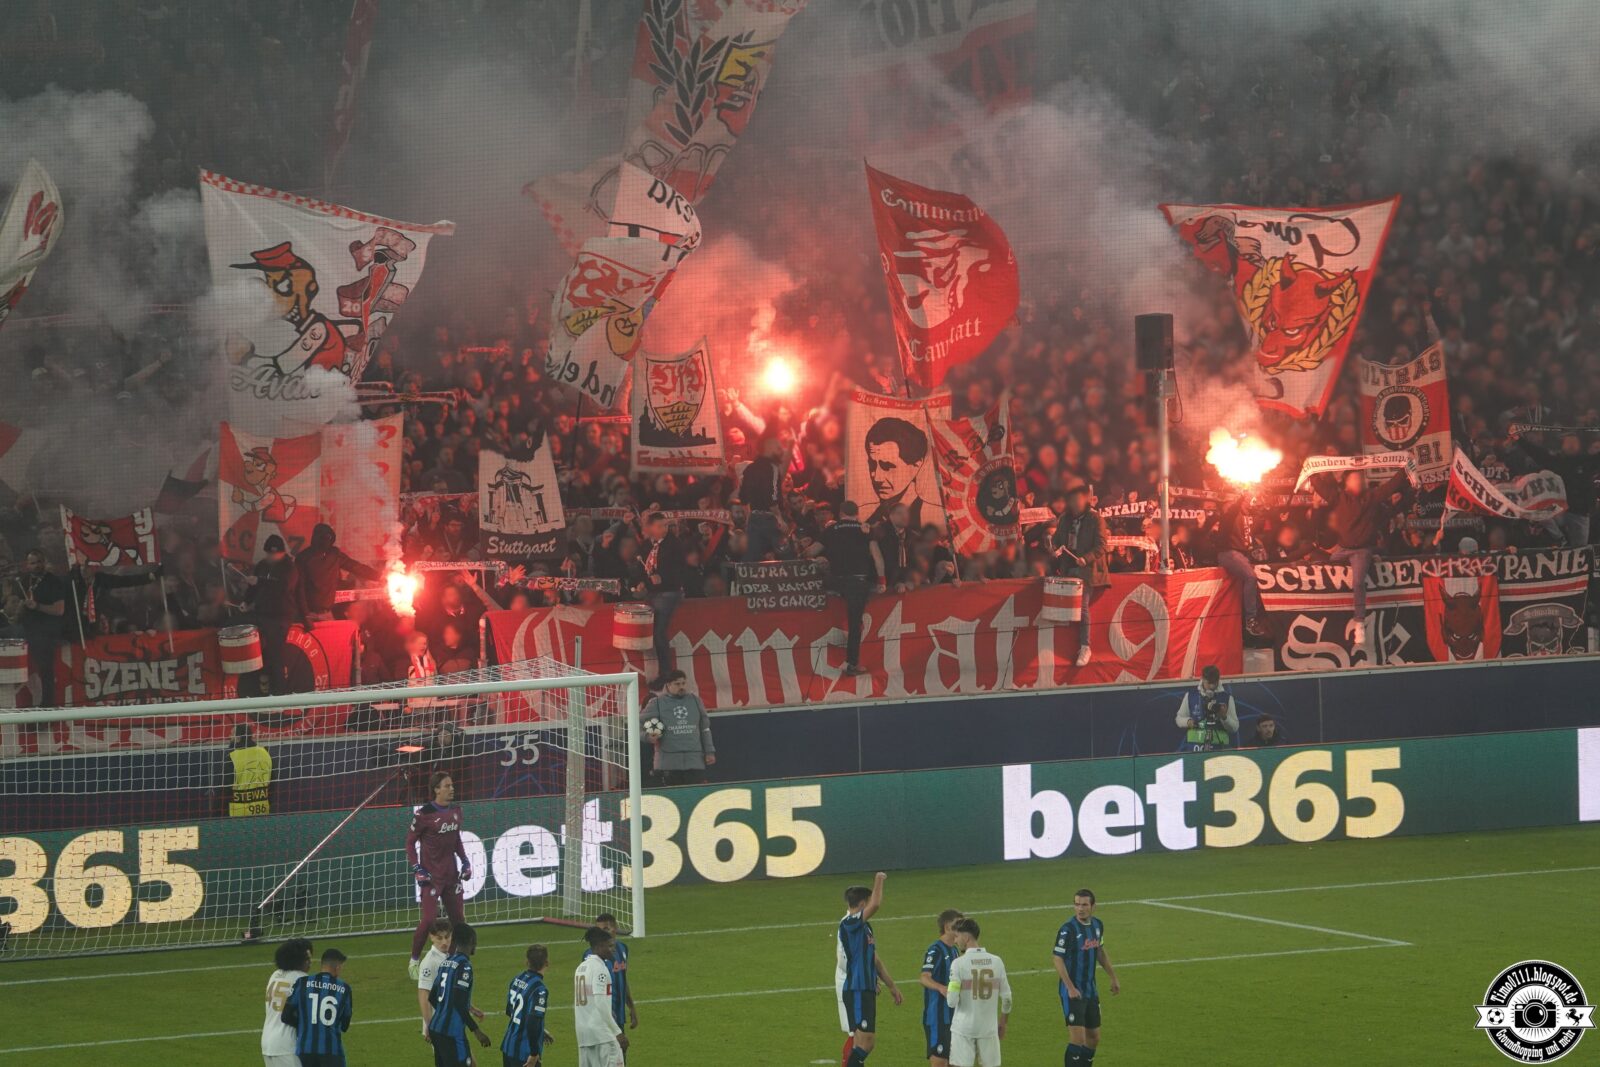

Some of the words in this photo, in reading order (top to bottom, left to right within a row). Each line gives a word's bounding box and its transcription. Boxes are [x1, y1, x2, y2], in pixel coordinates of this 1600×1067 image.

[486, 536, 557, 559] Stuttgart
[738, 565, 788, 579] ULTRA
[793, 563, 818, 576] IST
[741, 583, 771, 595] DER
[777, 580, 823, 594] KAMPF
[746, 596, 776, 609] UMS
[779, 594, 826, 608] GANZE
[1108, 578, 1223, 683] 97
[84, 659, 179, 699] SZENE
[500, 733, 540, 767] 35
[248, 804, 267, 815] 986
[1002, 747, 1405, 860] bet365
[306, 980, 346, 994] BELLANOVA
[574, 974, 588, 1007] 10
[970, 968, 994, 1000] 16
[308, 992, 338, 1026] 16
